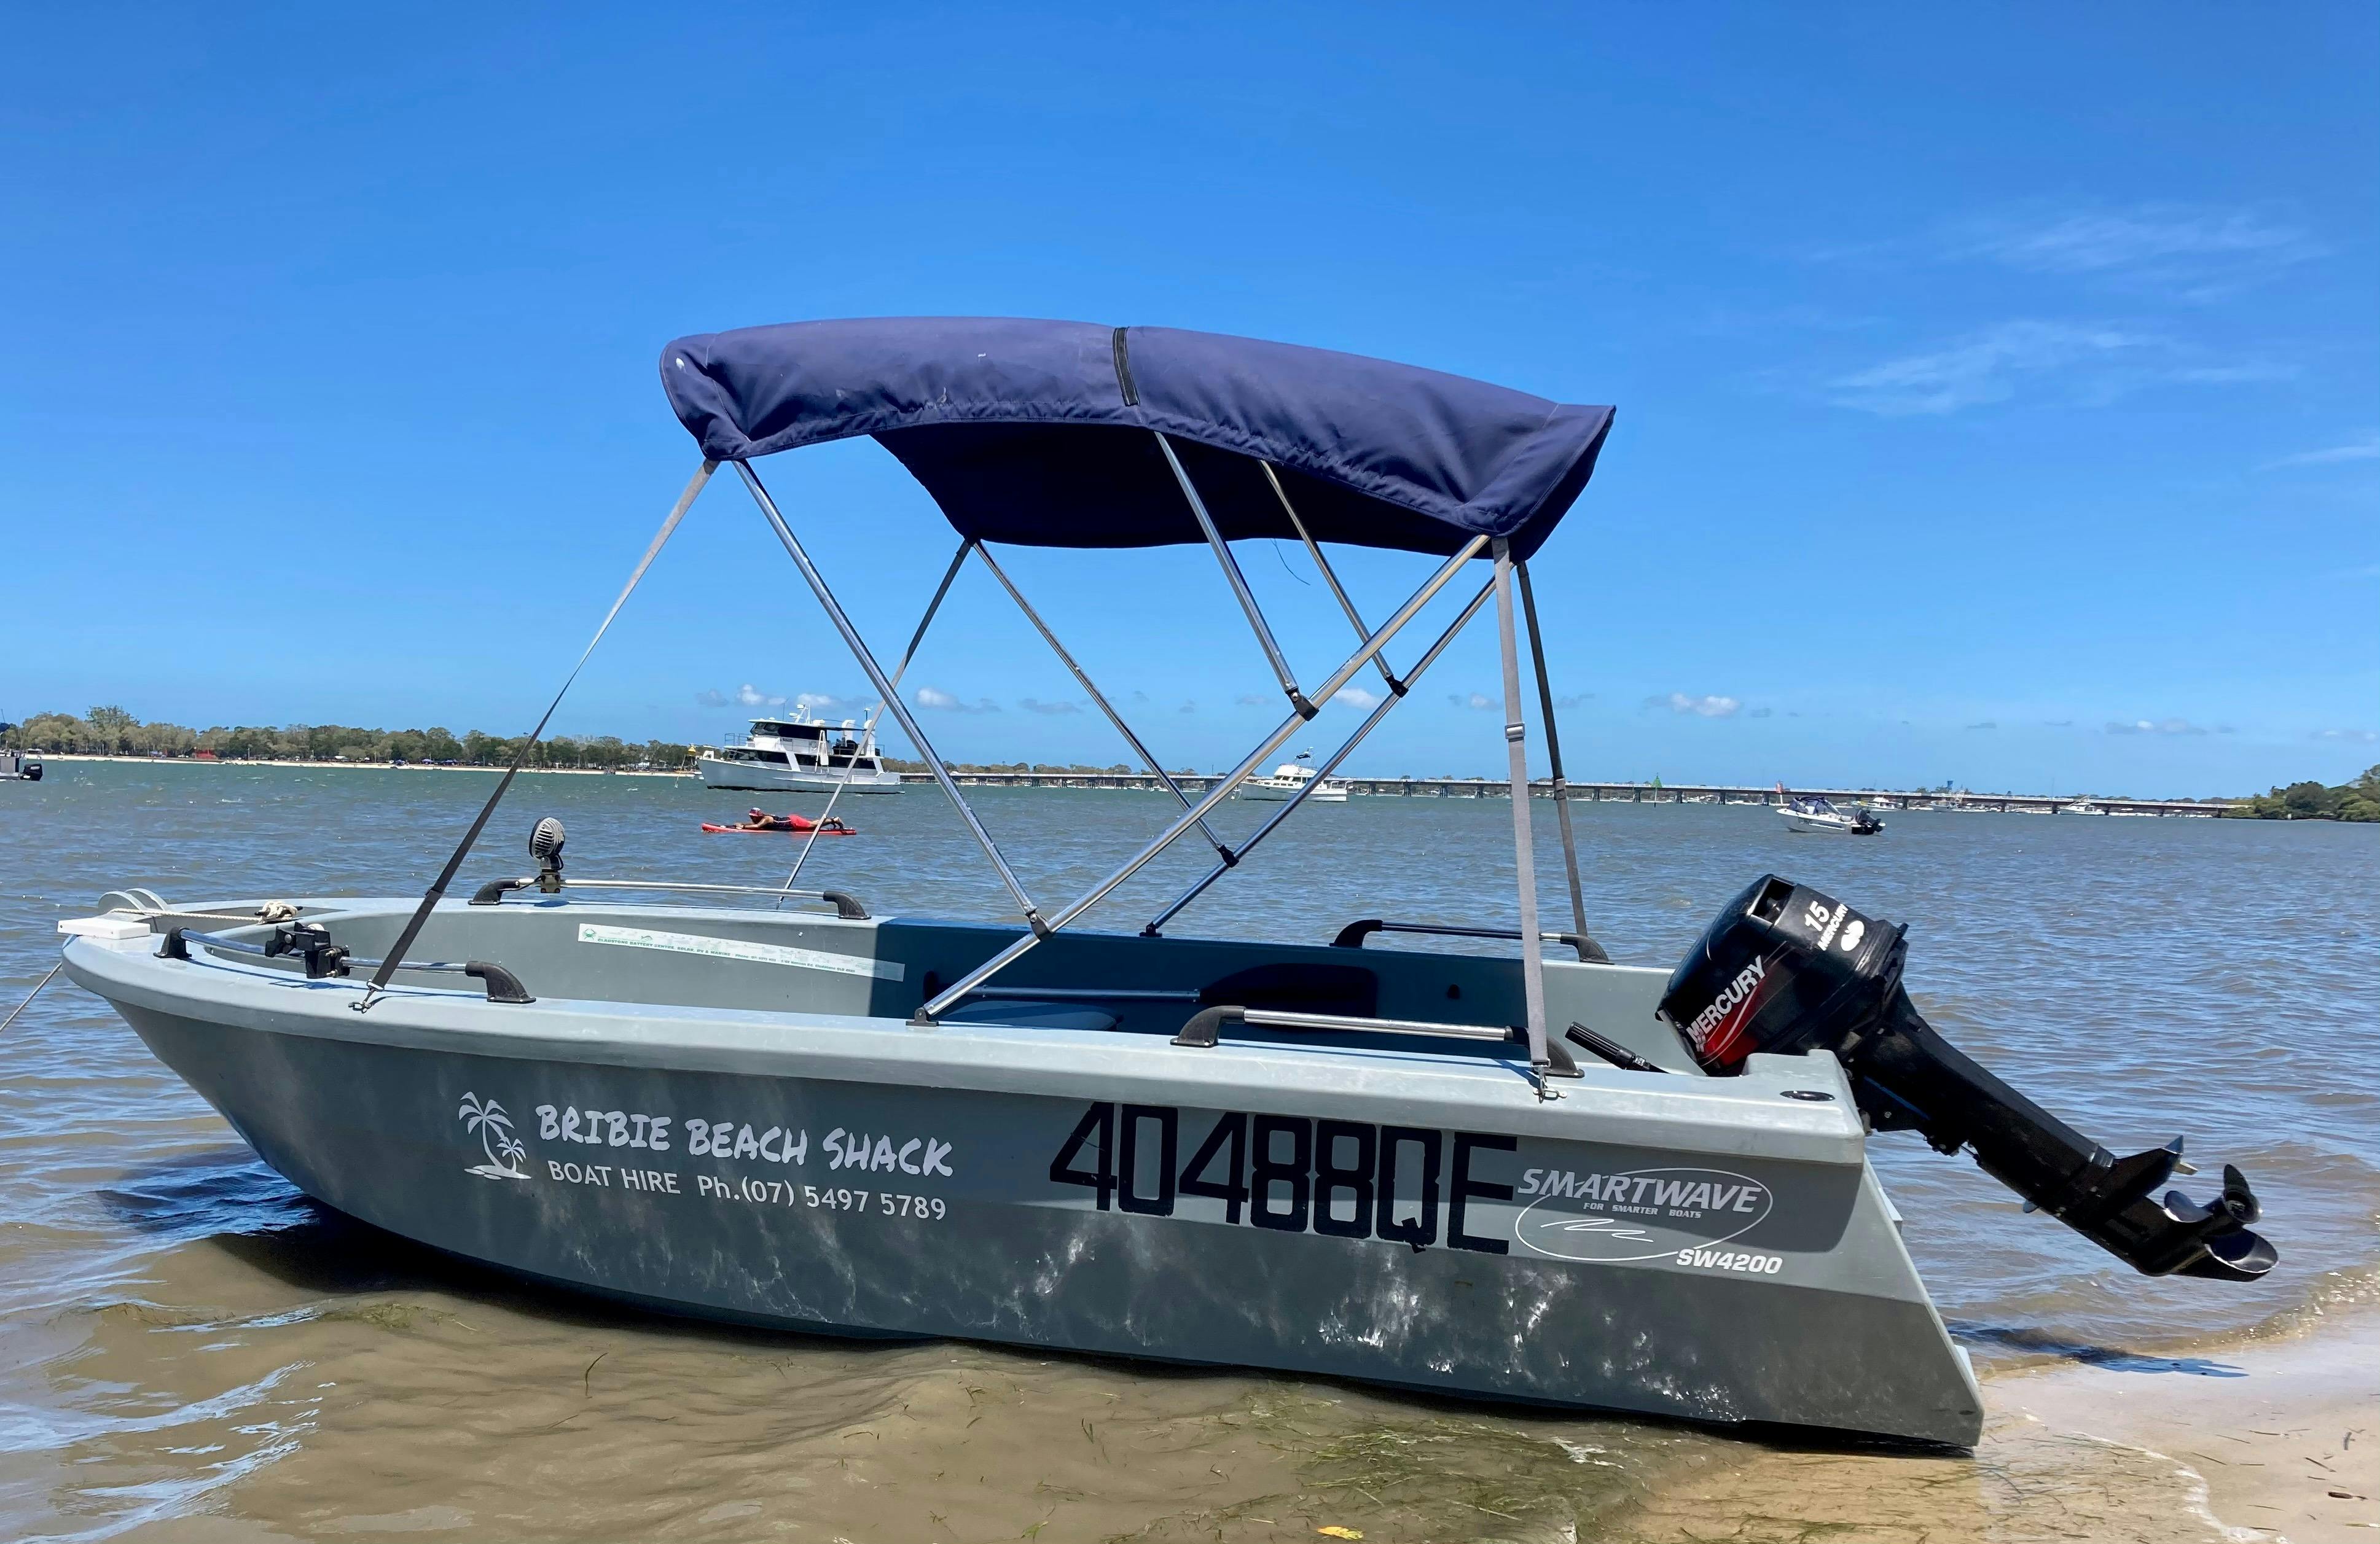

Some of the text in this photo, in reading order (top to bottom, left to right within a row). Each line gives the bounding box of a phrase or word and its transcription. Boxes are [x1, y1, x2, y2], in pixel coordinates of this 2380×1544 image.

[1804, 900, 1830, 932] 15
[1686, 954, 1766, 1044] MERCURY
[536, 1104, 954, 1177] BRIBIE BEACH SHACK
[547, 1160, 612, 1188] BOAT
[621, 1168, 681, 1195] HIRE
[805, 1186, 867, 1212] 5497
[880, 1193, 947, 1221] 5789
[1049, 1101, 1517, 1255] 40488QE
[1517, 1168, 1763, 1213] SMARTWAVE
[1583, 1201, 1702, 1219] FOR SMARTER BOATS
[1676, 1249, 1783, 1274] SW4200
